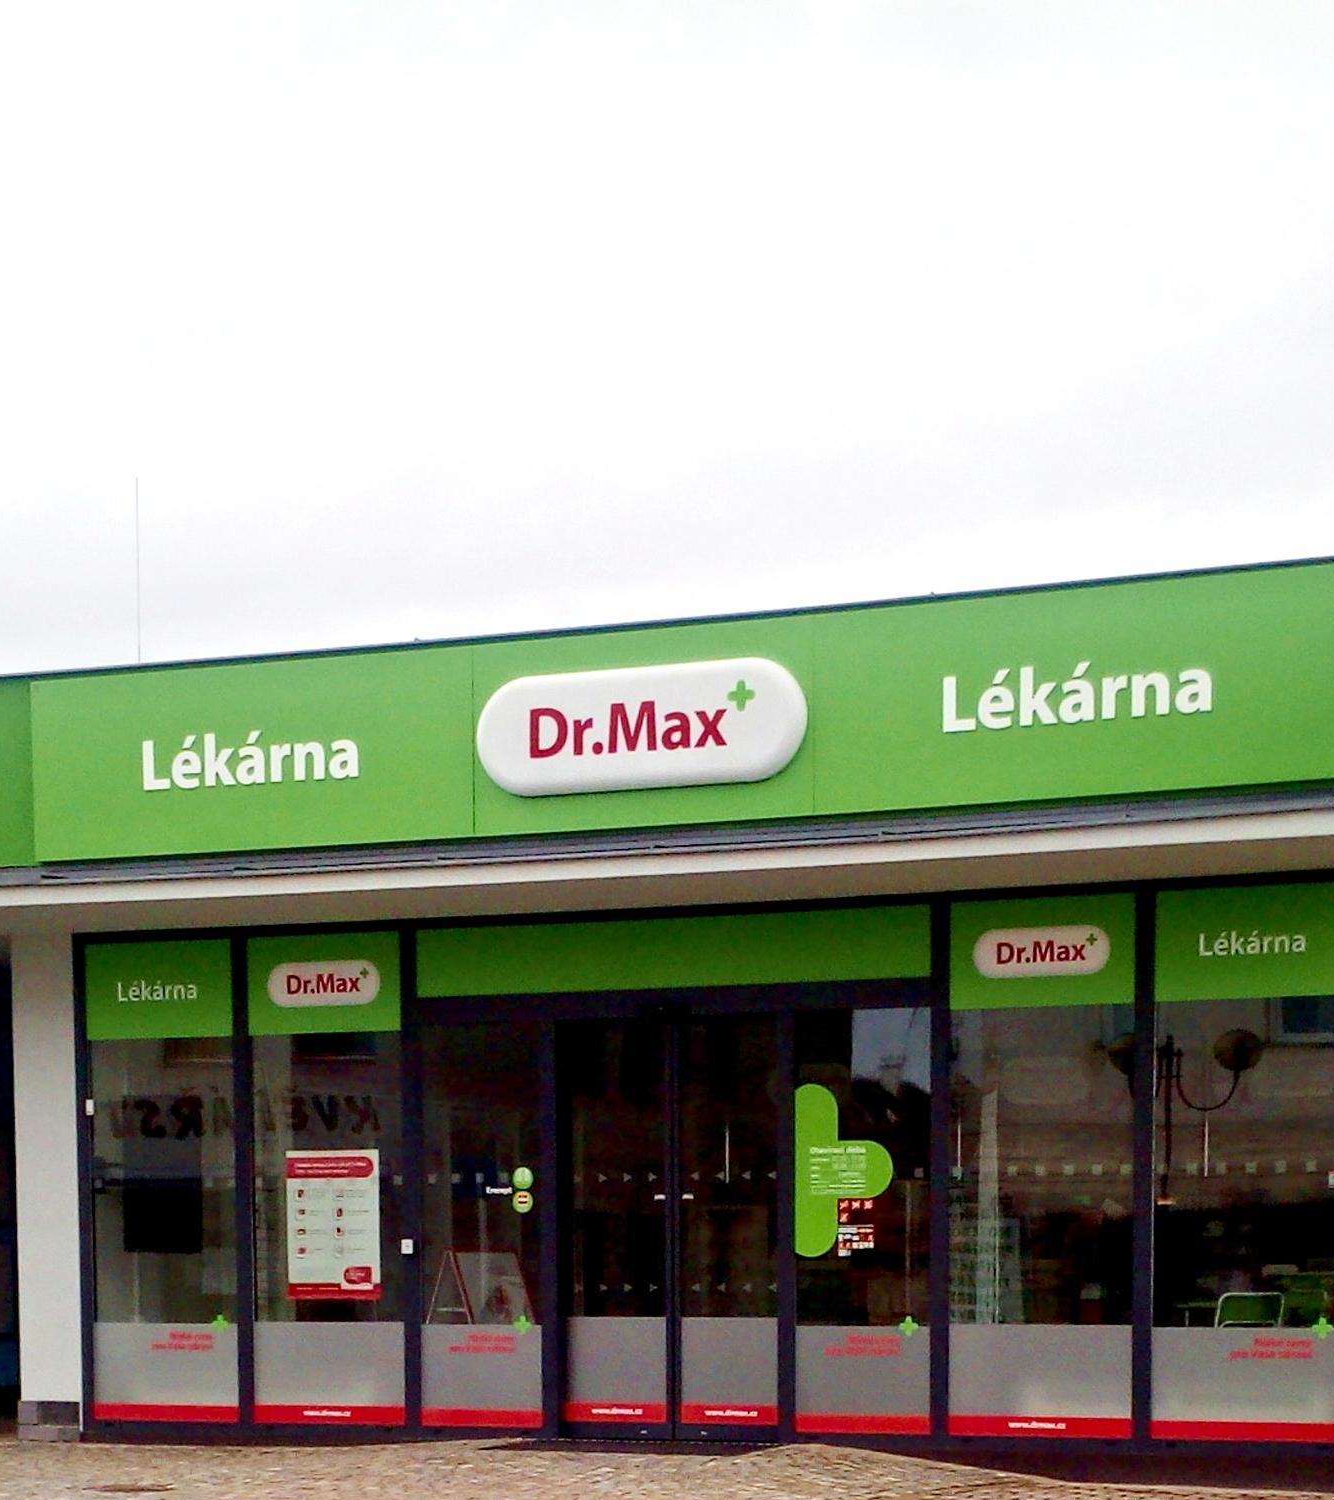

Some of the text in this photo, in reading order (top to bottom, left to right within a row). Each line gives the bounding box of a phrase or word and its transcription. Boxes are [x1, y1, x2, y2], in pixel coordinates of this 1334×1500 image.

[941, 660, 1214, 733] Lékárna
[528, 699, 728, 759] Dr.Max
[141, 730, 360, 792] Lékárna
[996, 940, 1086, 965] Dr.Max
[1198, 930, 1307, 957] Lékárna
[117, 980, 198, 1003] Lékárna
[286, 973, 361, 996] Dr.Max
